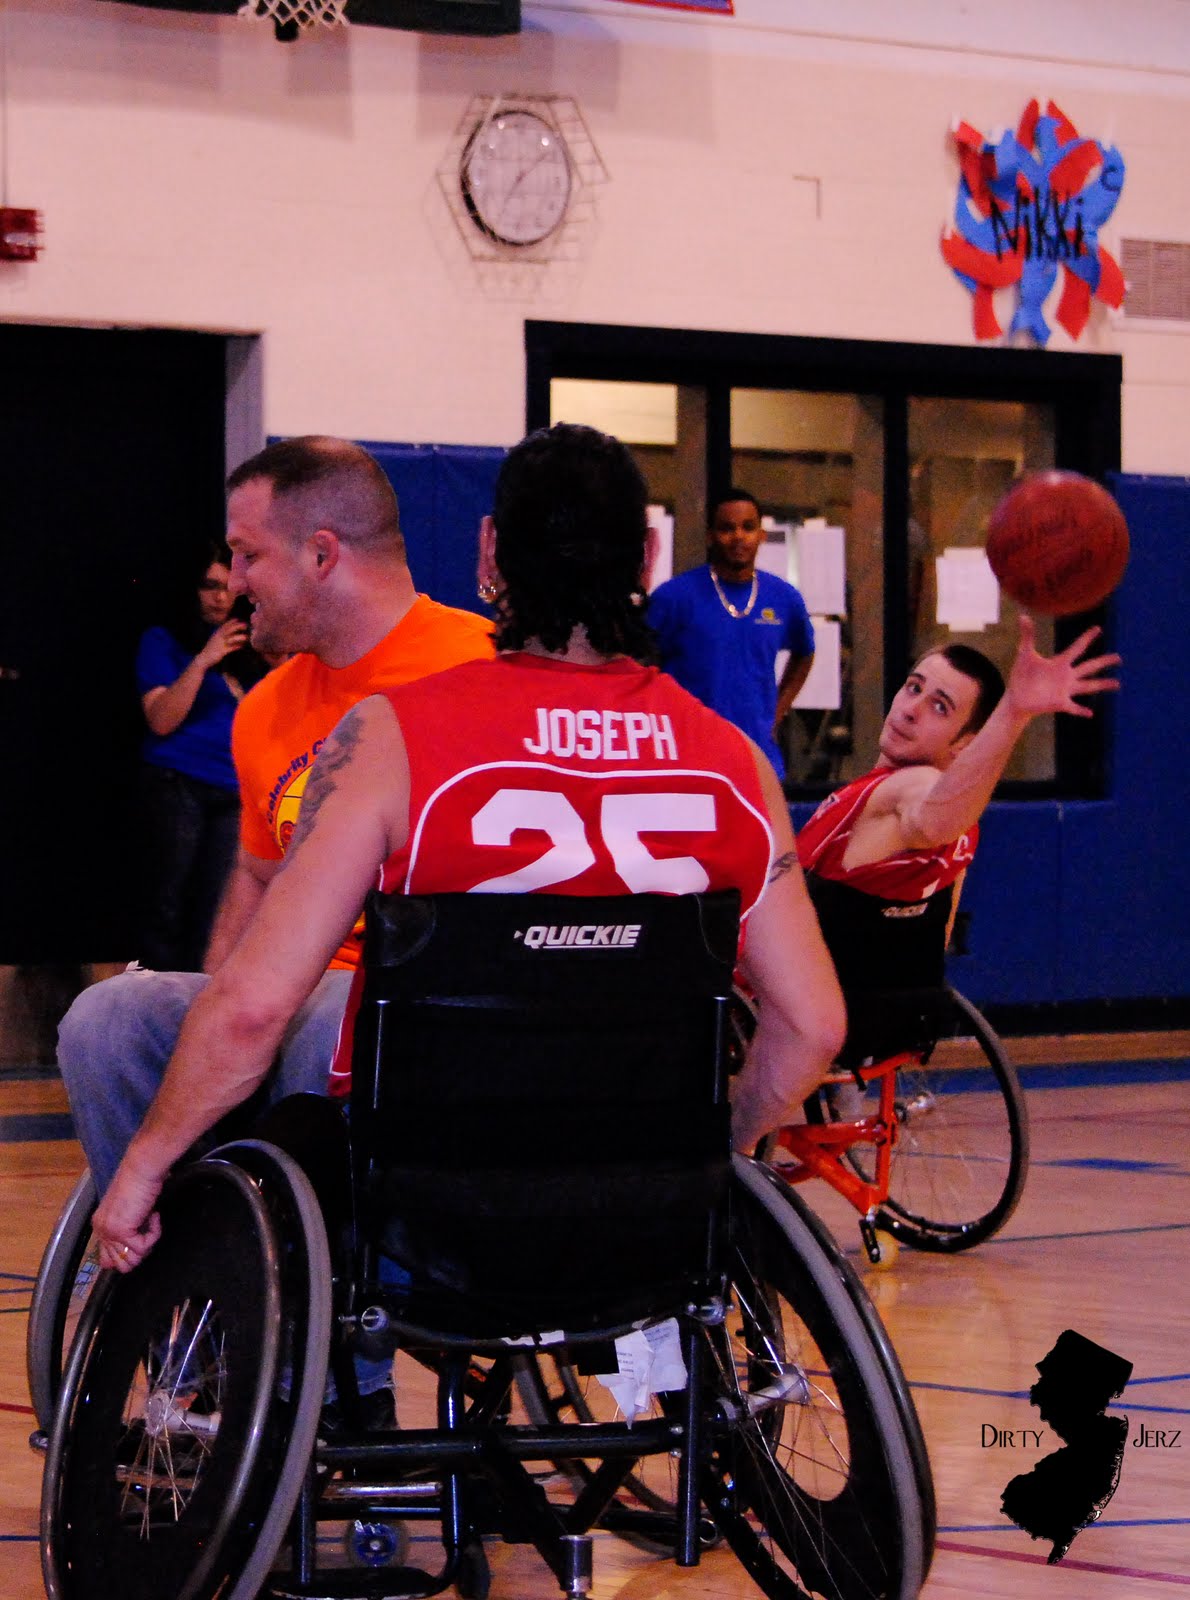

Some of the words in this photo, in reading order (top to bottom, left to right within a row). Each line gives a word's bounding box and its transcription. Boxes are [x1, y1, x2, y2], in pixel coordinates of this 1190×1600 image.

[523, 707, 679, 761] JOSEPH
[466, 788, 717, 896] 25
[523, 924, 642, 949] QUICKIE
